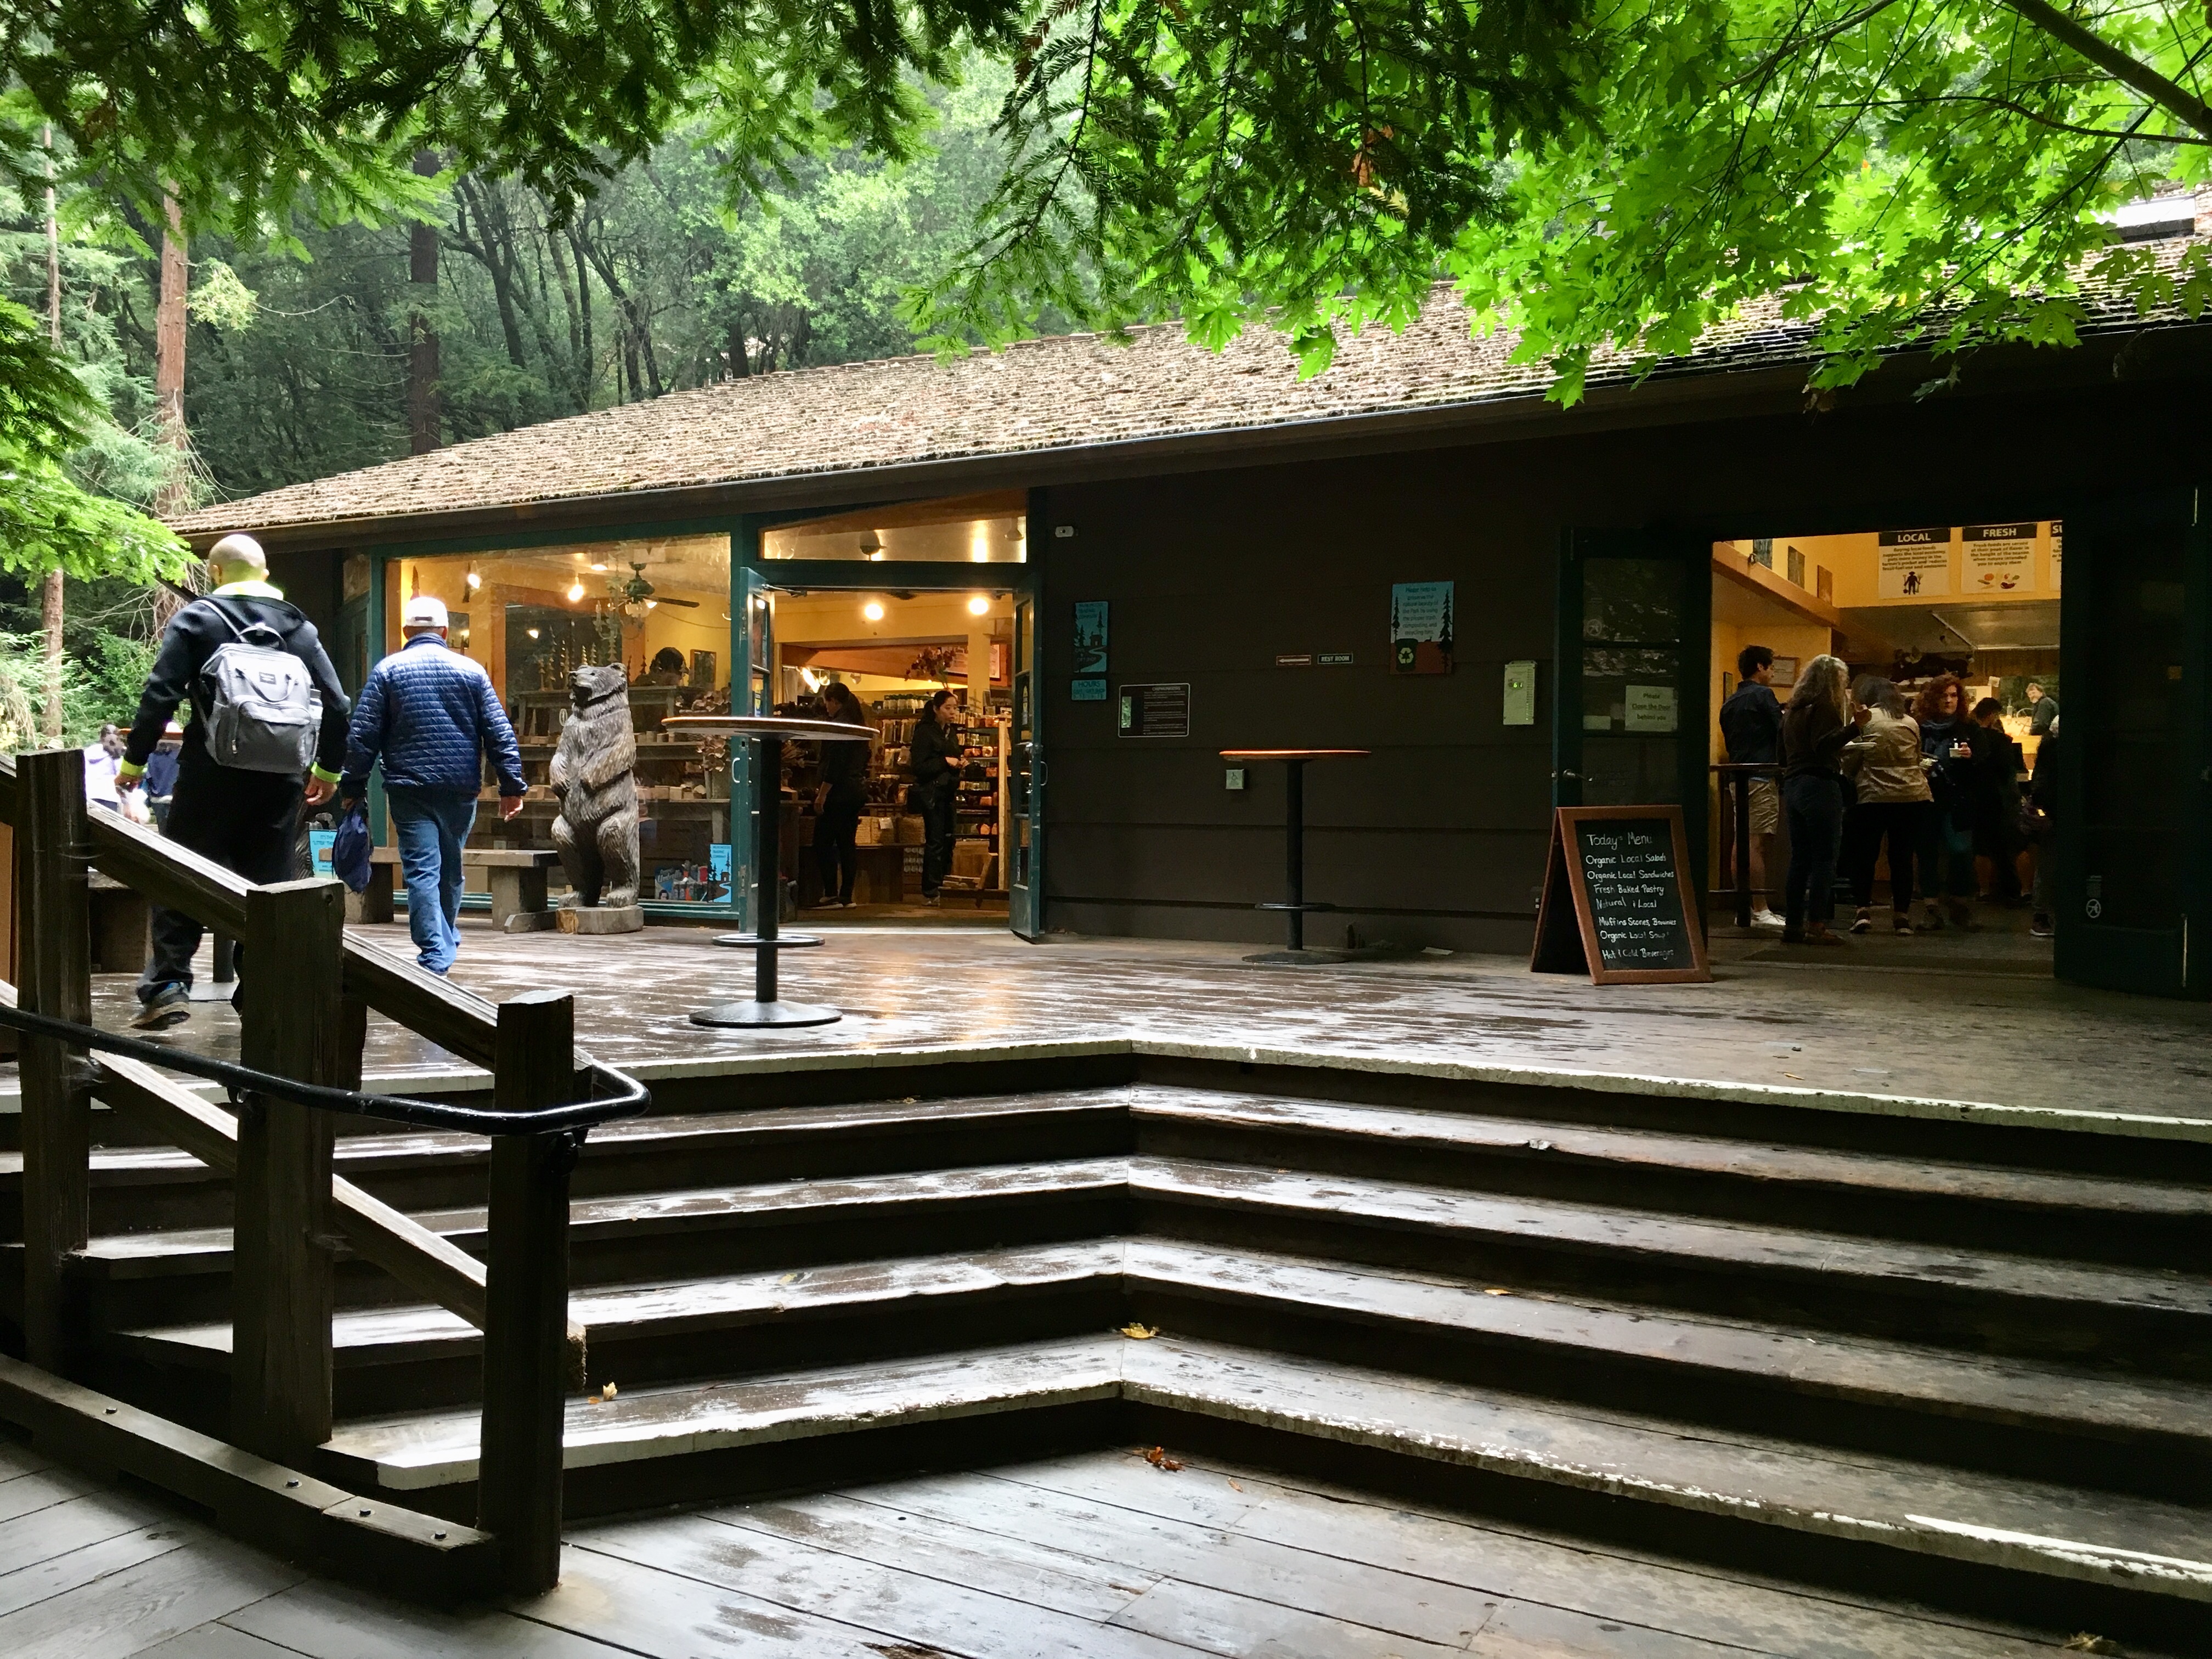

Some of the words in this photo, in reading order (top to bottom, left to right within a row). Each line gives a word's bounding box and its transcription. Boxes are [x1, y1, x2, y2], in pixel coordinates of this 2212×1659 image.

[1898, 533, 1931, 543] LOCAL
[1983, 528, 2017, 538] FRESH
[1627, 832, 1652, 845] Menu
[1585, 855, 1617, 868] Organic
[1621, 854, 1643, 863] Local
[1645, 853, 1666, 862] Salads
[1587, 871, 1616, 883] Organic
[1618, 871, 1636, 879] Local
[1639, 870, 1674, 879] Sandwiches
[1593, 883, 1615, 894] Fresh
[1617, 884, 1640, 894] Baked
[1641, 884, 1664, 896] Pastry
[1596, 896, 1627, 910] Natural
[1638, 899, 1657, 908] Local
[1598, 917, 1627, 926] Muffins
[1600, 930, 1627, 943] Organic
[1602, 950, 1616, 960] Hot
[1623, 949, 1639, 957] Cold
[1640, 948, 1674, 960] Beverages
